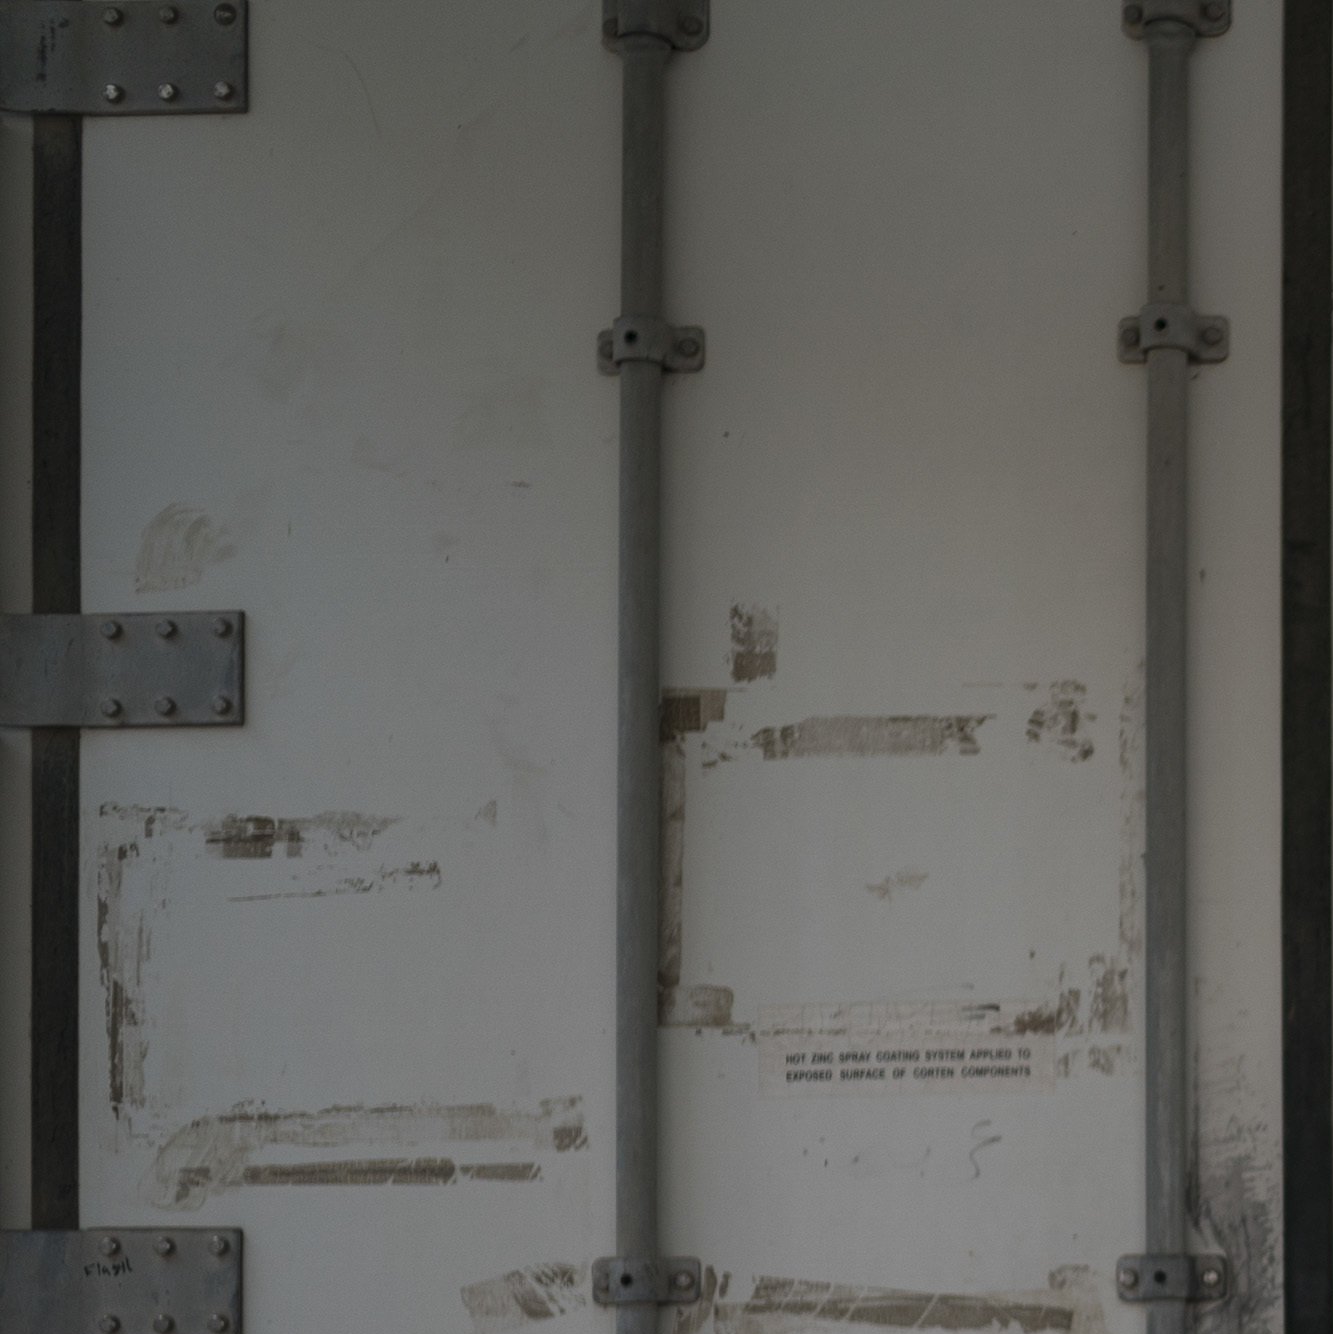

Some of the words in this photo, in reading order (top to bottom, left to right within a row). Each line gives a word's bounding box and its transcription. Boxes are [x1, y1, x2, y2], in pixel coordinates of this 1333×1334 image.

[786, 1053, 806, 1065] HOT
[811, 1052, 833, 1064] ZINC
[839, 1051, 870, 1064] SPRAY
[876, 1050, 920, 1062] COATING
[925, 1049, 964, 1061] SYSTEM
[969, 1048, 1011, 1060] APPLIED
[1018, 1048, 1031, 1059] TO
[786, 1070, 832, 1082] EXPOSED
[840, 1068, 885, 1080] SURFACE
[892, 1068, 906, 1079] OF
